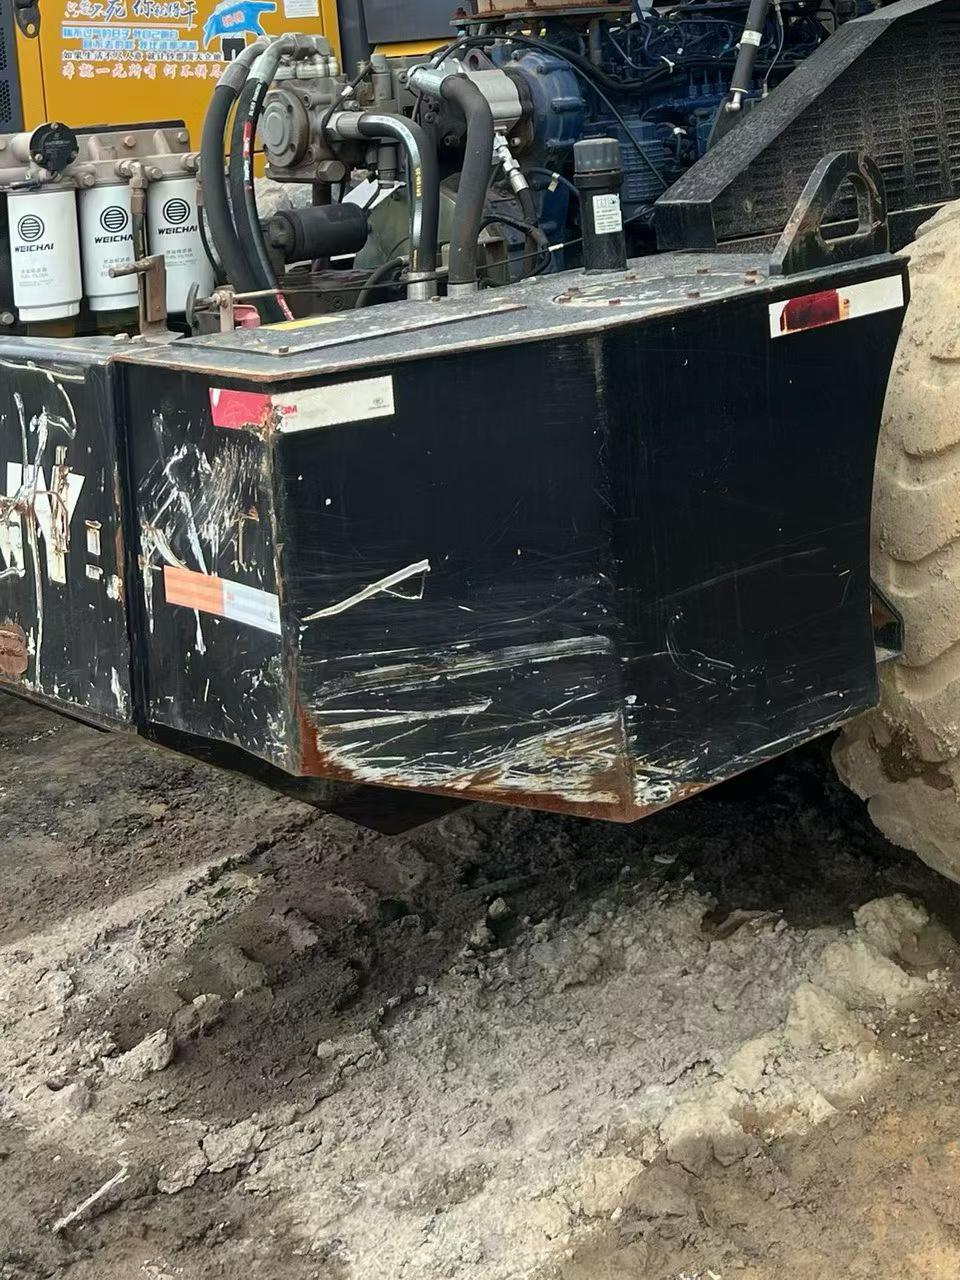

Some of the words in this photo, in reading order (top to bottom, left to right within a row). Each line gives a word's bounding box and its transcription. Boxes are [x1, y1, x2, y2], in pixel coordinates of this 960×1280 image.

[157, 225, 198, 235] WEICHAI
[94, 234, 133, 244] WEICHA
[15, 243, 54, 253] WEICHAI
